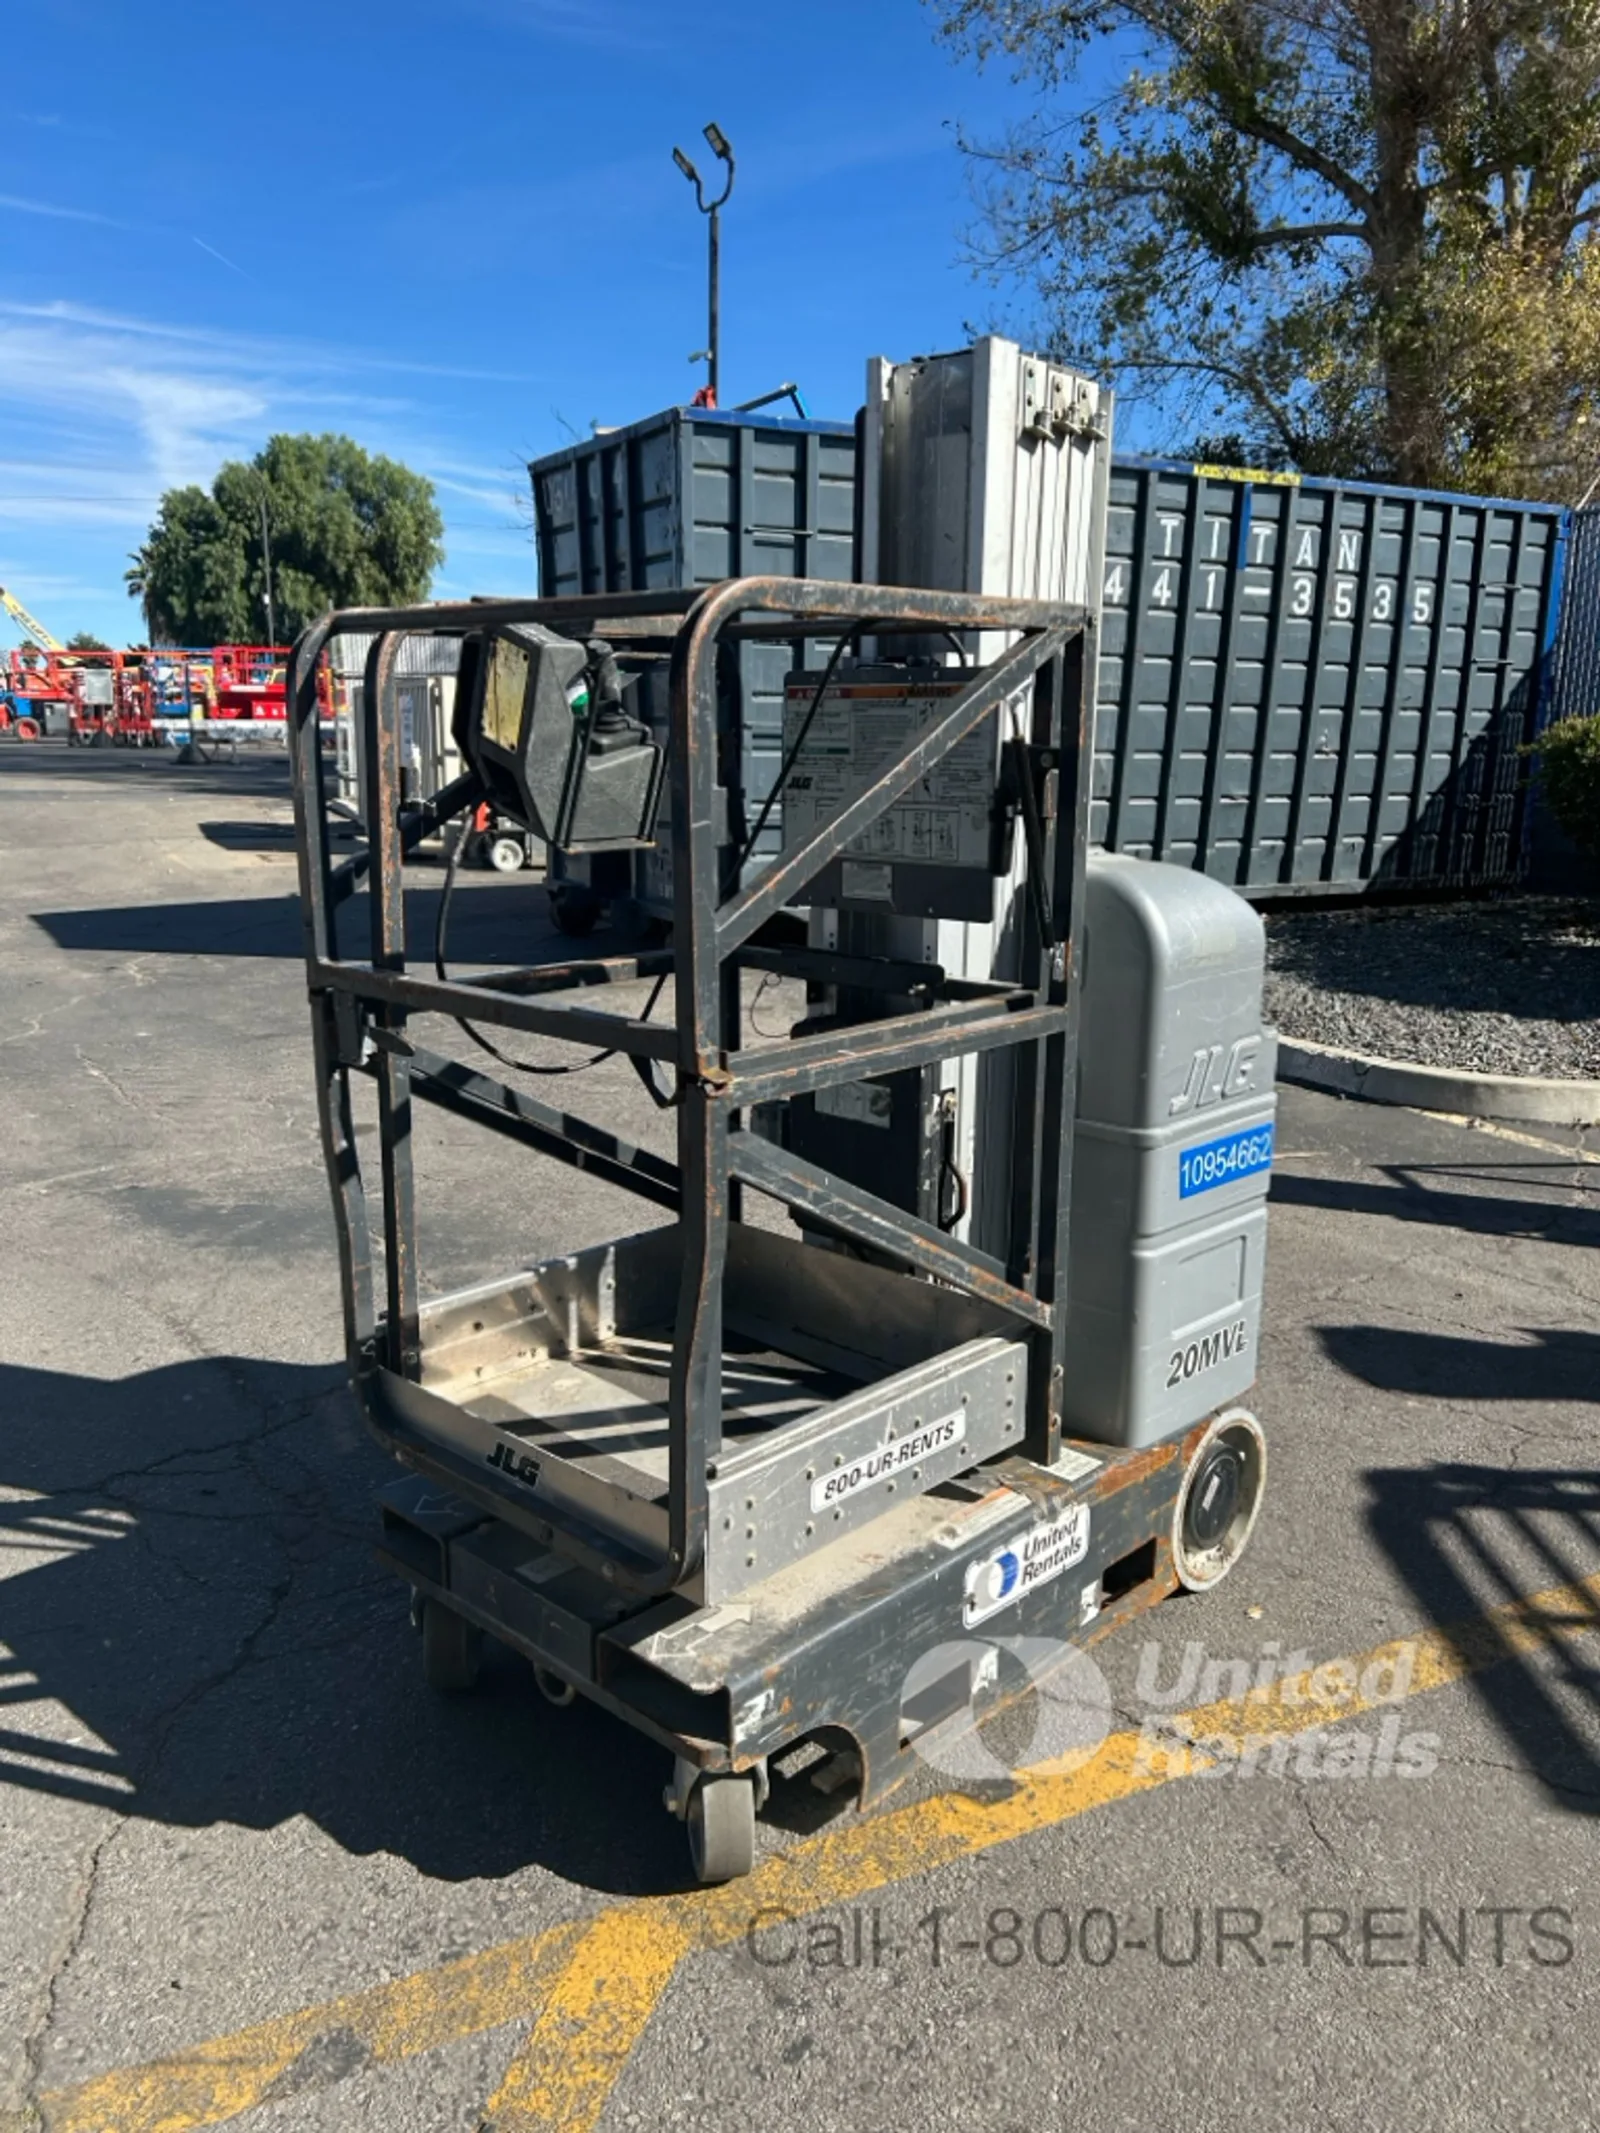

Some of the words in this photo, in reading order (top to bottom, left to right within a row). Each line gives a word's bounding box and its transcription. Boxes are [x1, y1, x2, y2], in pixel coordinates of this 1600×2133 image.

[1159, 518, 1358, 569] TITAN
[1104, 566, 1430, 622] 441-3535
[1169, 1034, 1262, 1115] JLG
[1181, 1133, 1271, 1188] 10954662
[486, 1441, 541, 1488] JLG
[824, 1420, 955, 1500] 800-UR-RENTS
[1020, 1535, 1082, 1586] Rentals
[1022, 1512, 1079, 1561] United
